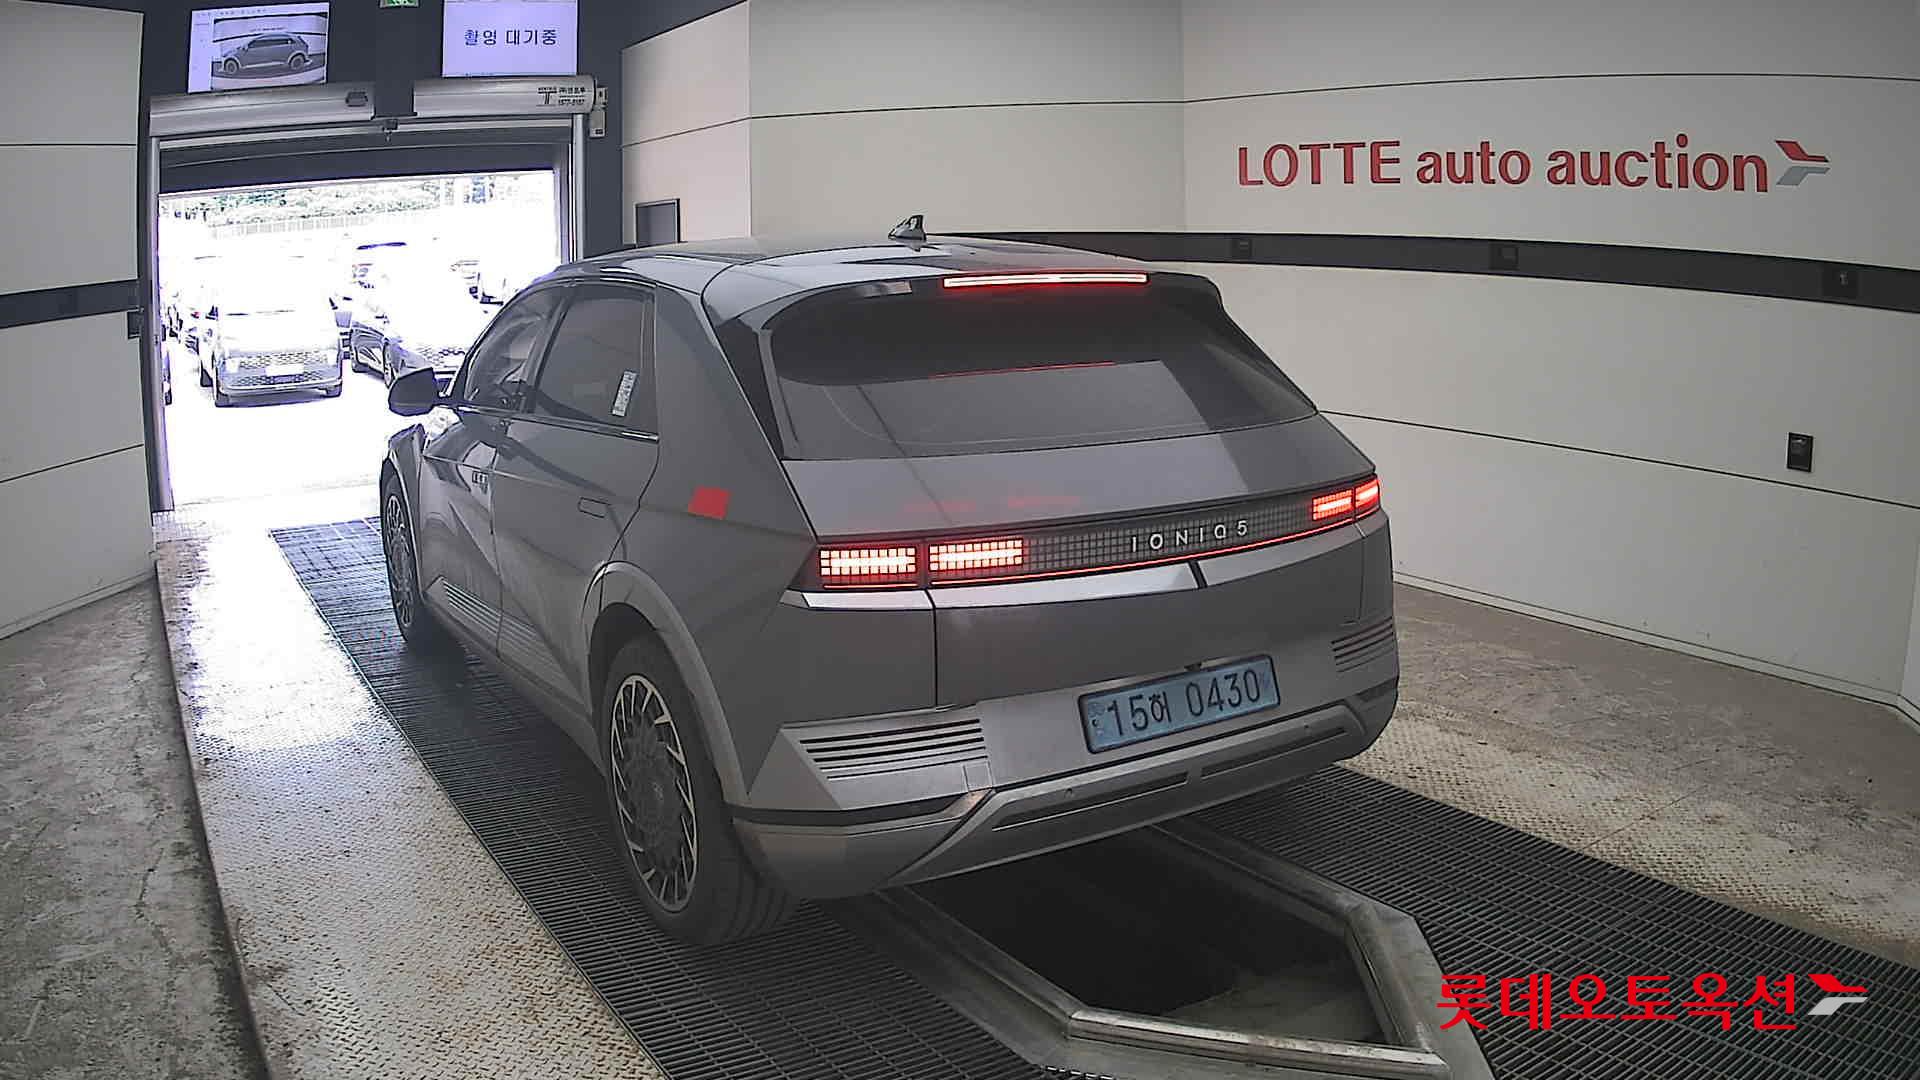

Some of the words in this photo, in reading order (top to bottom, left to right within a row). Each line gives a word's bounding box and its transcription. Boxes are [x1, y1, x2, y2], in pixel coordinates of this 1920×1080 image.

[505, 29, 557, 46] 대기중
[1238, 140, 1402, 187] LOTTE
[1416, 140, 1532, 186] auto
[1547, 133, 1769, 194] auction
[1106, 690, 1173, 737] 15허
[1185, 668, 1261, 718] 0430
